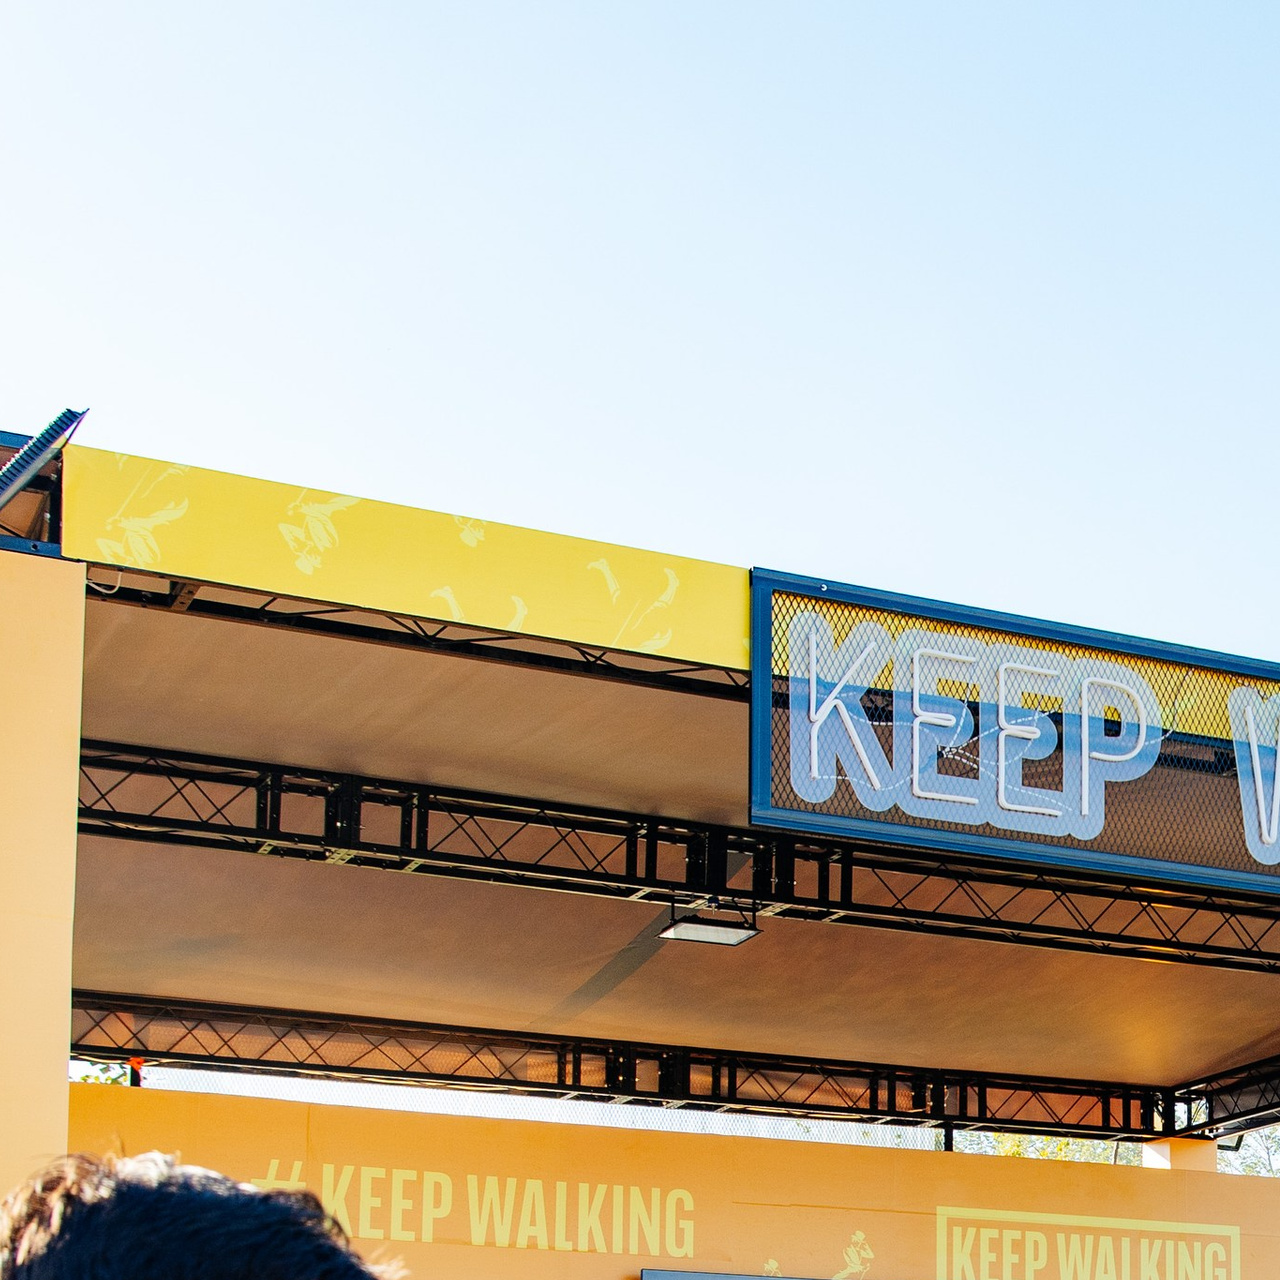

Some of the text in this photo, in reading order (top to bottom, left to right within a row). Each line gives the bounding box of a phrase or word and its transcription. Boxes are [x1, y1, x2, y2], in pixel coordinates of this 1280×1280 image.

[795, 617, 1158, 834] KEEP
[321, 1163, 453, 1243] KEEP
[467, 1175, 695, 1258] WALKING
